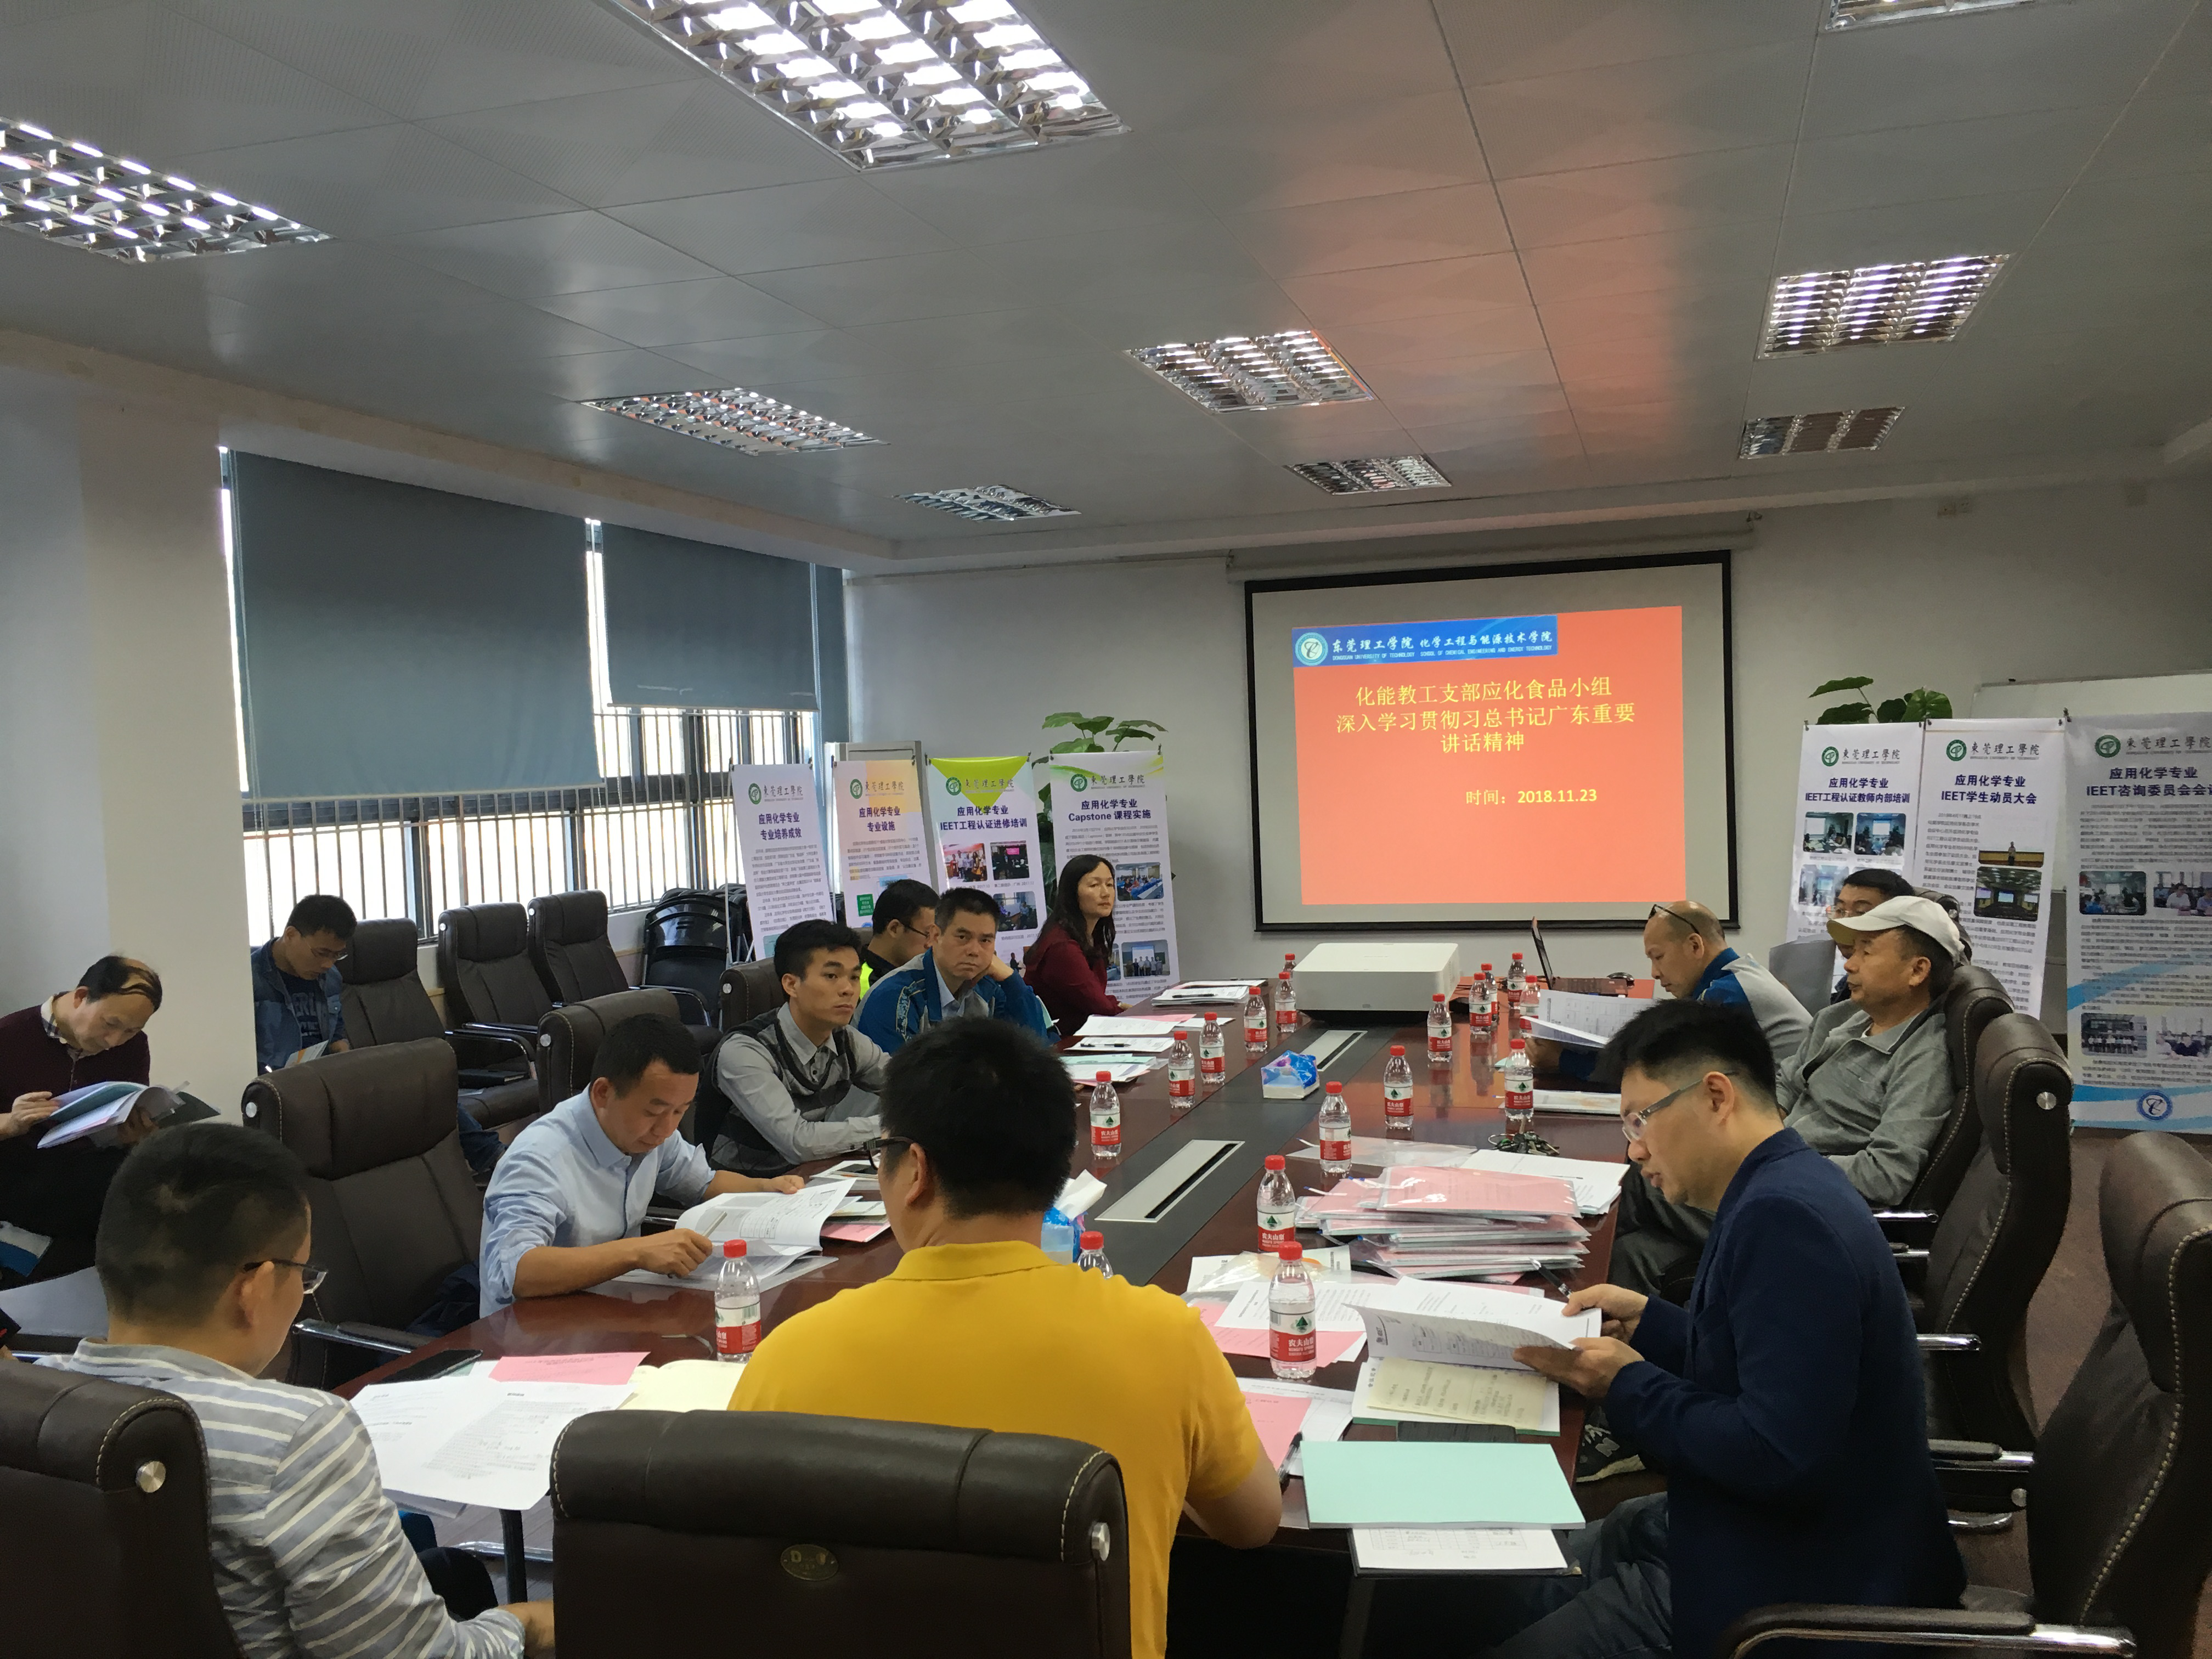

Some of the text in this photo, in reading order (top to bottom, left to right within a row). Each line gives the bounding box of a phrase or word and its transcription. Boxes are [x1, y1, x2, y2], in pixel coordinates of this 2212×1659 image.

[1332, 630, 1553, 653] 东莞理工学院 化学工程与能源技术学院
[1356, 676, 1612, 707] 化能教工支部应化食品小组
[1336, 702, 1636, 733] 深入学习贯彻习总书记广东重要
[1441, 731, 1524, 754] 讲话精神
[2109, 766, 2198, 780] 应用化学专业
[1829, 777, 1889, 789] 应用化学专业
[1955, 775, 2026, 787] 应用化学专业
[2086, 784, 2212, 797] IEET咨询委员会会
[1805, 792, 1910, 803] IEET工程认证教师内部培训
[1941, 791, 2037, 804] IEET学生动员大会
[957, 805, 1009, 816] 应用化学专业
[1081, 799, 1138, 810] 应用化学专业
[758, 812, 800, 825] 应用化学专业
[859, 806, 901, 819] 应用化学专业
[1068, 809, 1152, 822] Capstone 课程实施
[867, 821, 896, 832] 专业设施
[940, 817, 1028, 831] IEET工程认证进修培训
[760, 827, 802, 840] 专业培养成效
